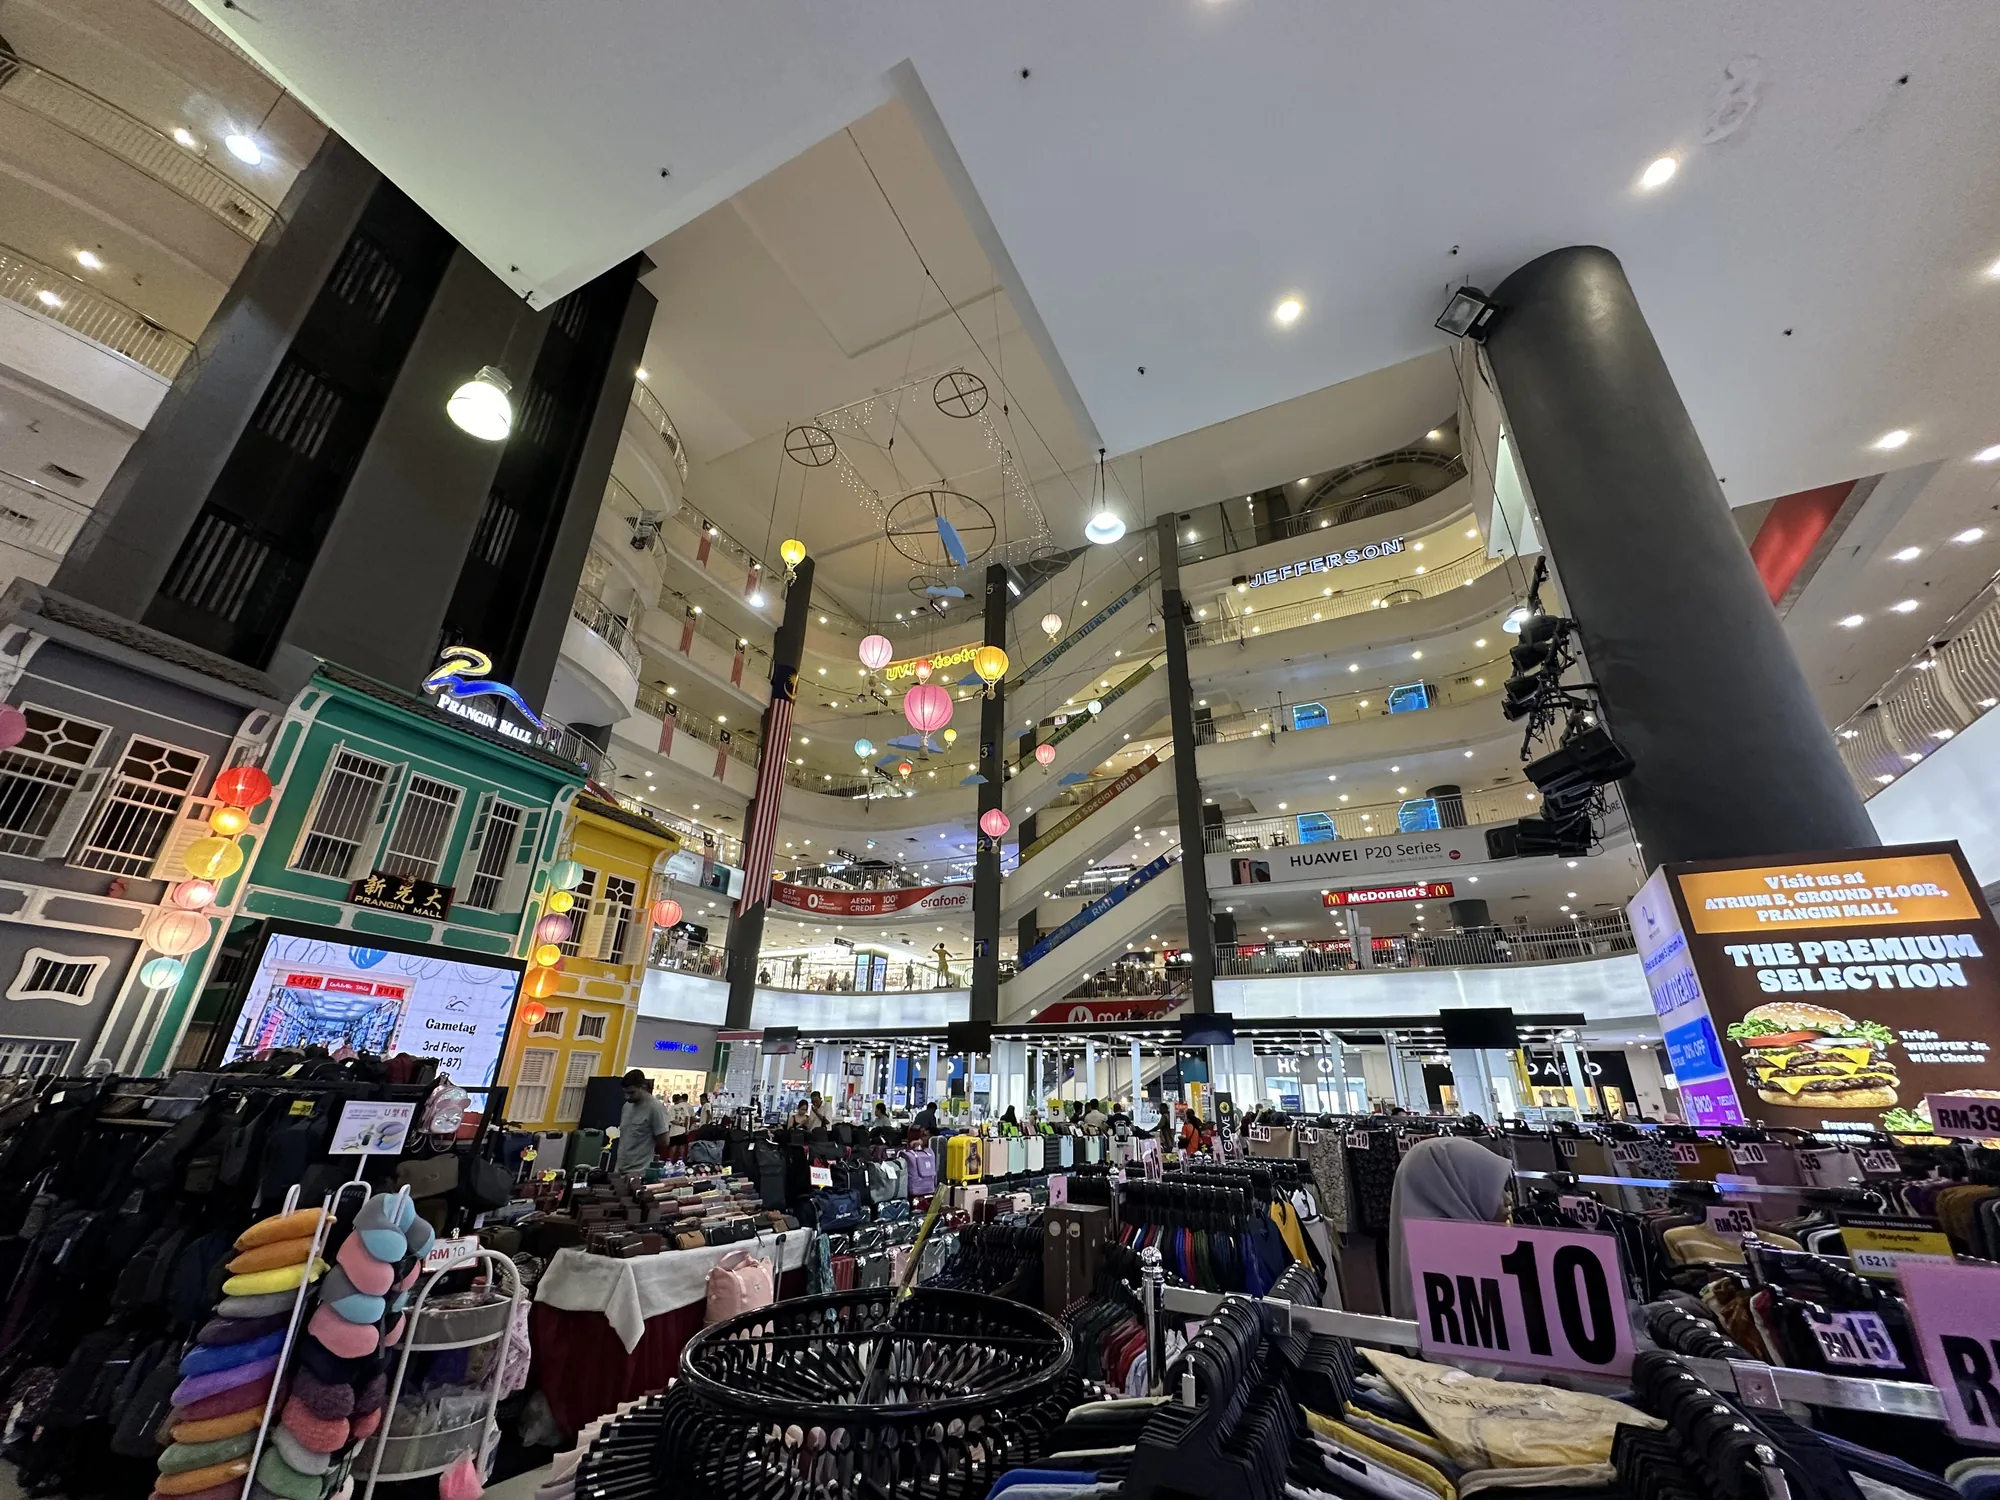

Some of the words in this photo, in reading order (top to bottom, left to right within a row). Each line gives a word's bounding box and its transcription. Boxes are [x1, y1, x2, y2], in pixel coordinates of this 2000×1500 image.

[1250, 538, 1402, 588] JEFFERSON
[1042, 641, 1073, 667] SENIOR
[1072, 614, 1108, 646] CITIZENS
[1107, 596, 1129, 617] RM10
[886, 646, 985, 681] UVPotecto
[1103, 687, 1126, 708] RM10
[437, 693, 497, 729] PRANGIN
[497, 719, 533, 745] MALL
[980, 746, 986, 758] 3
[1041, 825, 1064, 846] Early
[1063, 812, 1082, 831] Bird
[1082, 788, 1114, 816] Special
[1114, 773, 1138, 794] RM10
[978, 840, 986, 853] 2
[1290, 848, 1359, 868] HUAWEI
[1364, 845, 1393, 860] P20
[1396, 841, 1442, 856] Series
[1764, 873, 1816, 890] Visit
[1815, 875, 1842, 886] us
[1842, 871, 1867, 885] at
[782, 887, 797, 896] GST
[920, 892, 968, 908] erafone
[1347, 886, 1428, 903] McDonald's
[1704, 894, 1773, 910] ATRIUM
[1774, 893, 1795, 908] B,
[1793, 886, 1873, 905] GROUND
[1874, 883, 1950, 899] FLOOR,
[354, 894, 406, 912] PRANGIN
[412, 907, 443, 919] MALL
[849, 904, 876, 912] CREDIT
[850, 897, 873, 905] AEON
[1756, 905, 1842, 923] PRANGIN
[1842, 902, 1899, 917] MALL
[975, 943, 983, 958] 1
[1723, 942, 1801, 968] THE
[1797, 934, 1984, 965] PREMIUM
[1756, 962, 1969, 993] SELECTION
[426, 1018, 478, 1035] Gametag
[1898, 1030, 1940, 1041] Triple
[422, 1040, 441, 1053] 3rd
[441, 1042, 465, 1054] Floor
[1970, 1042, 1991, 1052] Jr.
[1907, 1053, 1940, 1064] With
[1938, 1053, 1986, 1064] Cheese
[1820, 1120, 1875, 1132] Supreme
[1937, 1104, 2000, 1133] RM39
[1221, 1115, 1233, 1152] GLOVE
[1251, 1127, 1270, 1141] RM10
[1299, 1128, 1319, 1142] RM0
[1348, 1132, 1368, 1148] RM10
[1614, 1143, 1641, 1161] RM10
[1671, 1144, 1697, 1162] M15
[1715, 1210, 1752, 1233] RM35
[1847, 1218, 1886, 1228] MAKLUMAT
[1878, 1232, 1921, 1243] Maybank
[429, 1248, 450, 1261] RM
[1857, 1254, 1889, 1268] 1521
[1423, 1241, 1617, 1365] RM10
[1820, 1316, 1892, 1361] RM15
[1939, 1333, 2000, 1430] R
